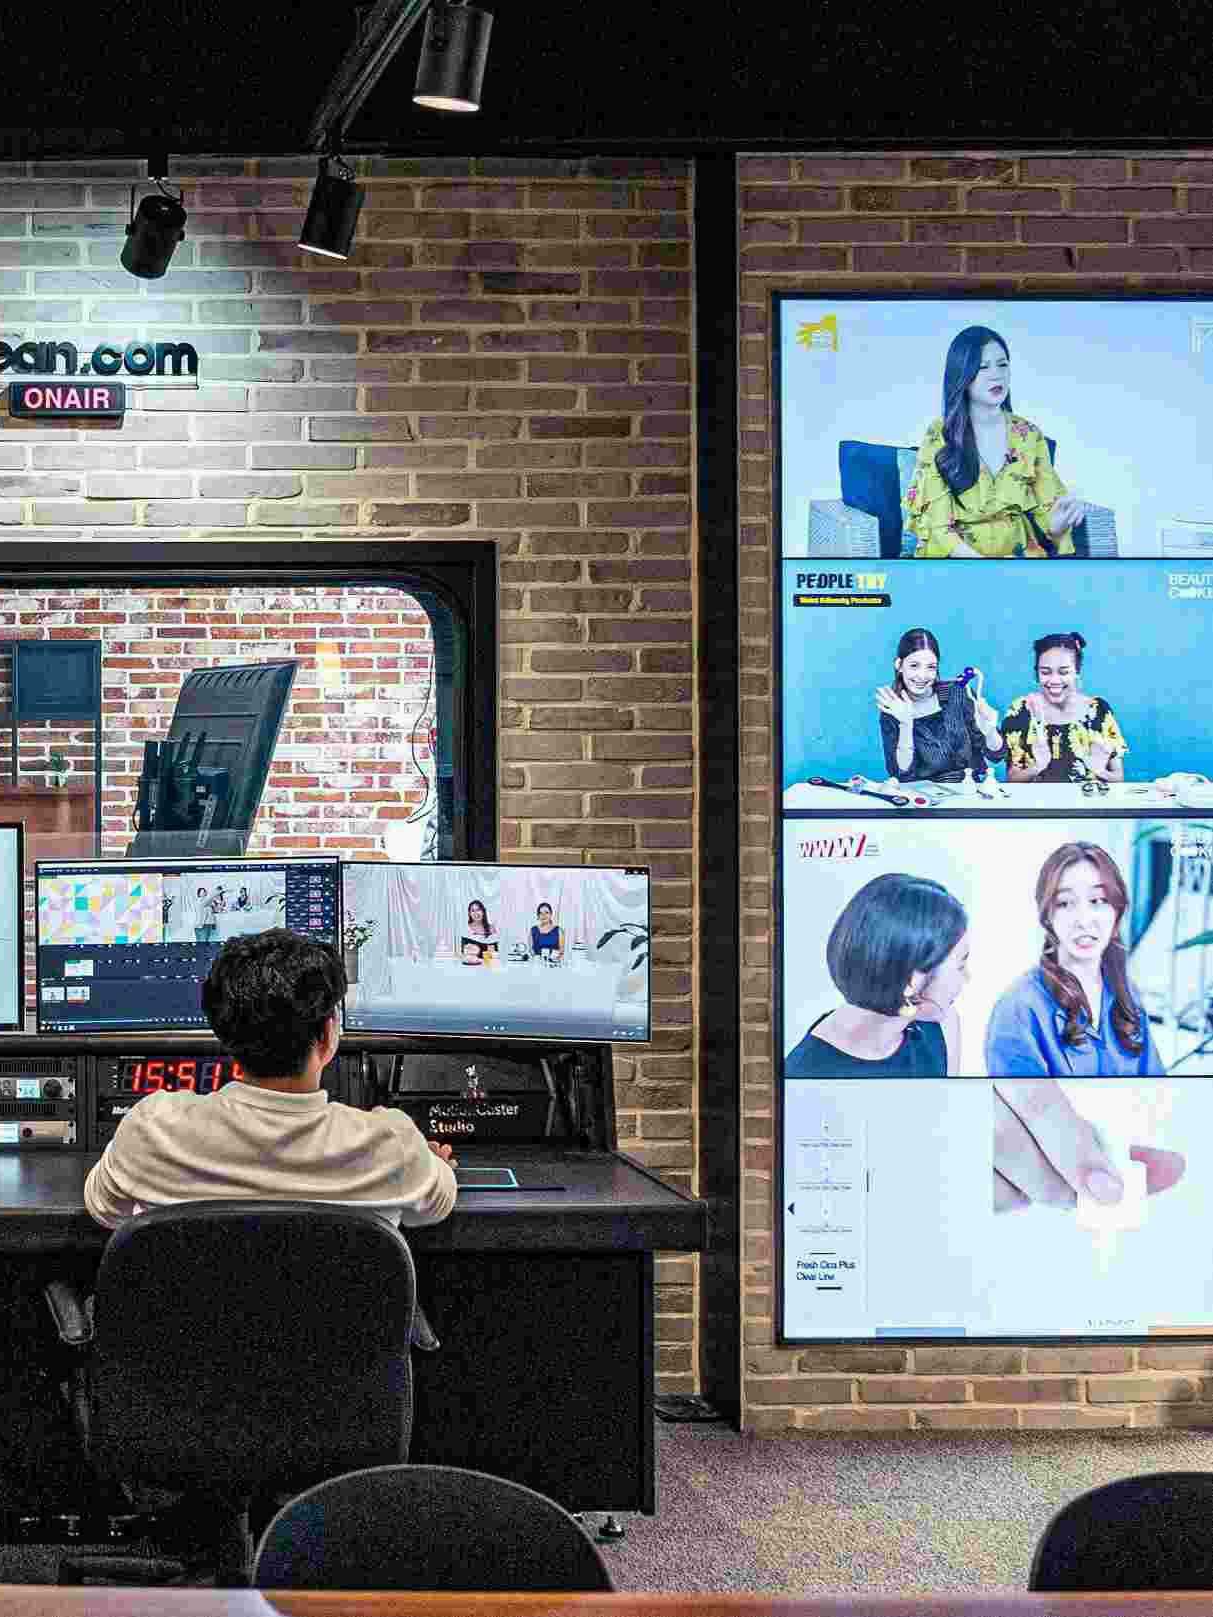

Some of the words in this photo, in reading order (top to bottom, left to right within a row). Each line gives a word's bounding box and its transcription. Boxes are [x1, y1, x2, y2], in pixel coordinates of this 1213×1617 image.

[25, 387, 109, 410] ONAIR
[796, 573, 852, 589] PEOPLE
[838, 1260, 856, 1270] Plus
